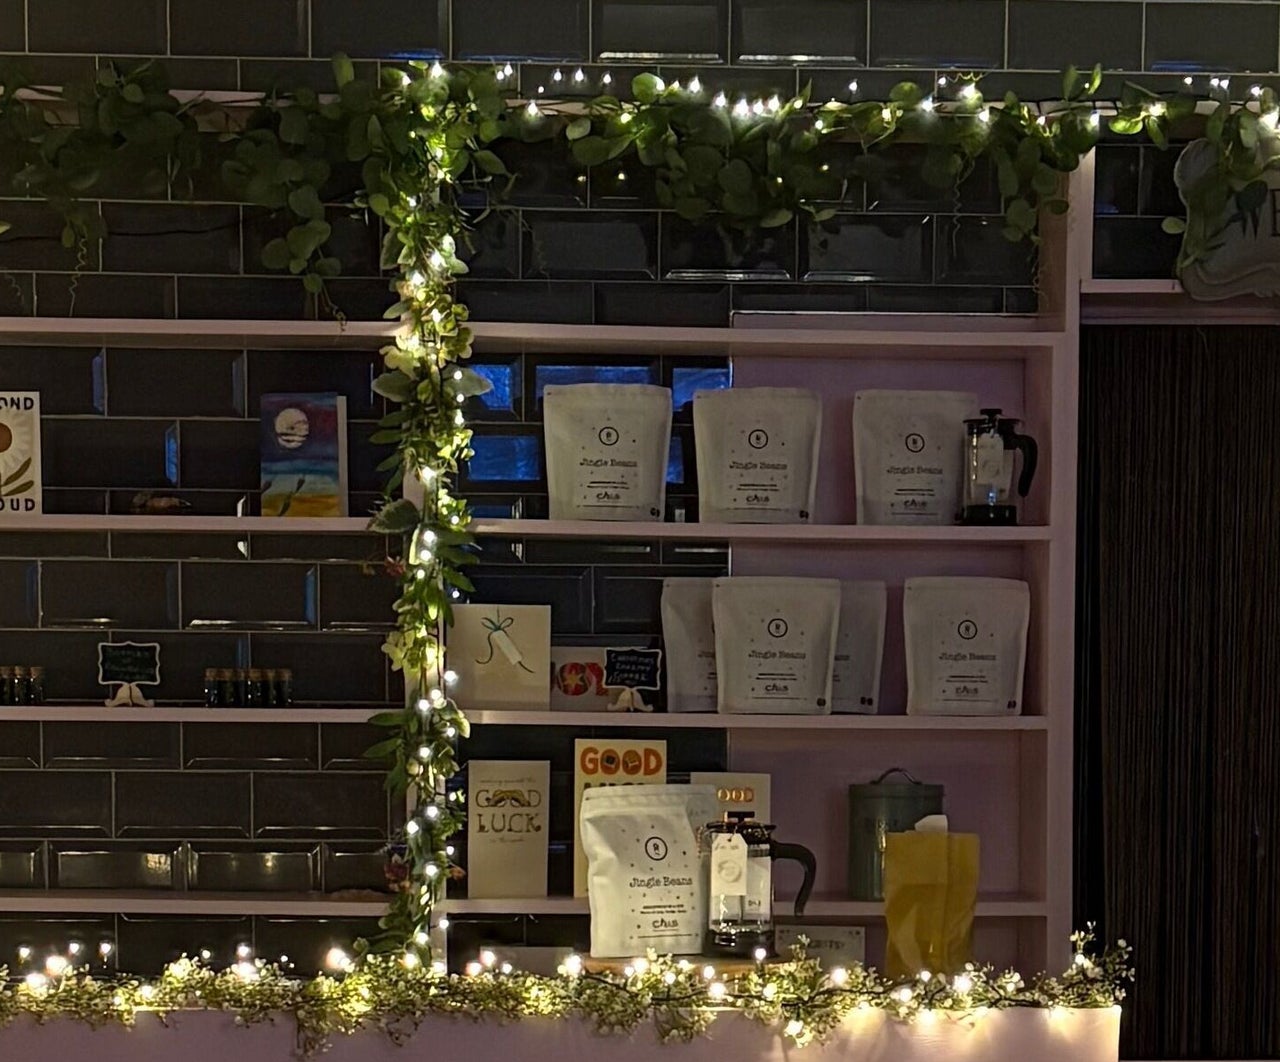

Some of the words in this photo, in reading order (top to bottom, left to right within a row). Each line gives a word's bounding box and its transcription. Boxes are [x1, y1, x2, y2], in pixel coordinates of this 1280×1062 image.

[580, 746, 663, 776] GOOD
[477, 813, 543, 834] LUCK
[629, 876, 661, 889] Jingle
[663, 876, 693, 887] Beans
